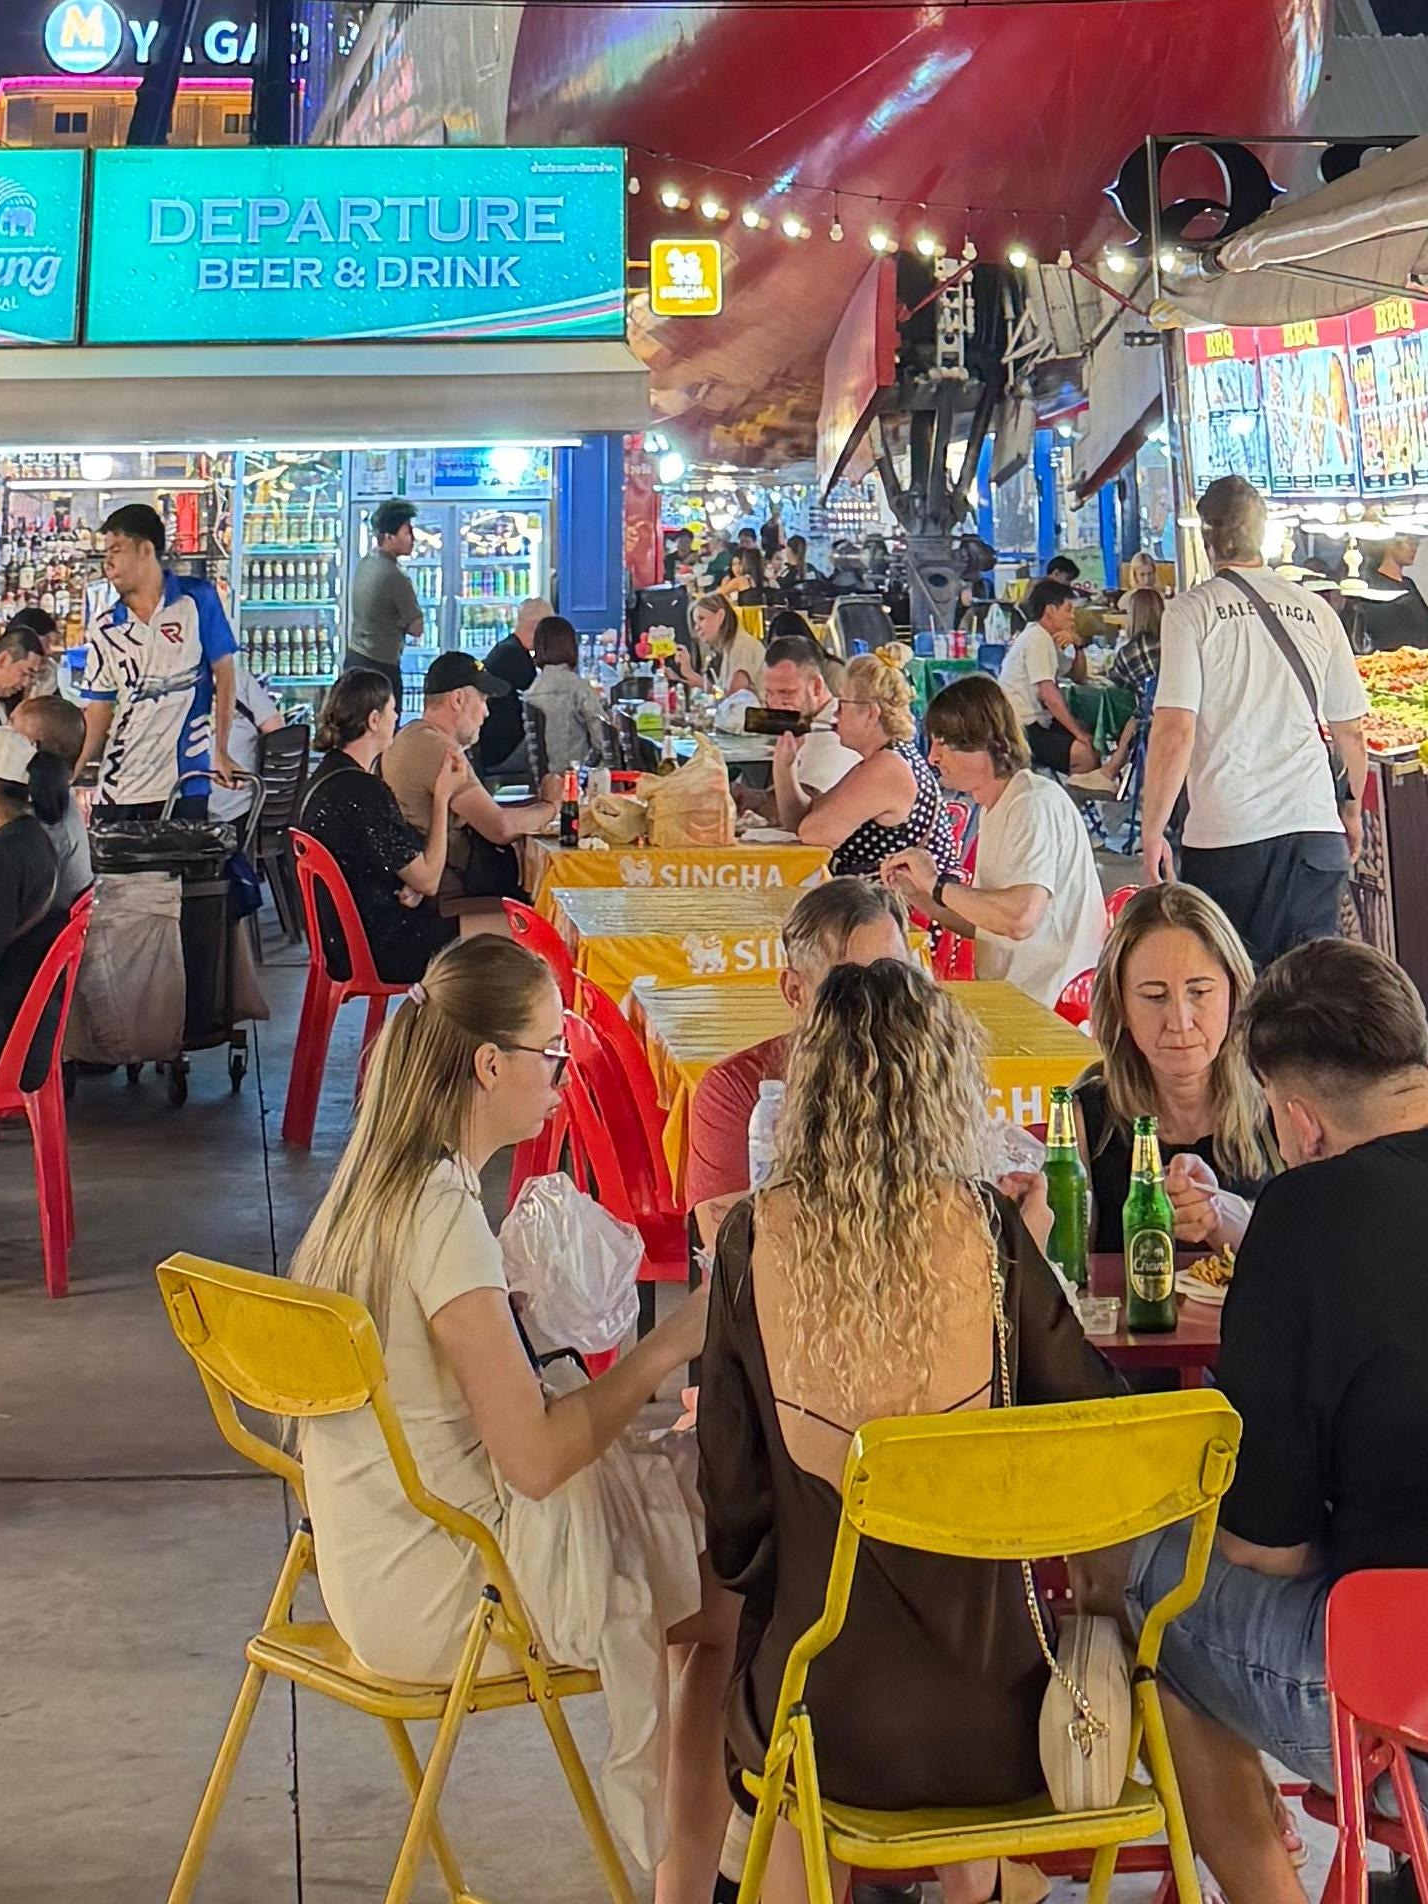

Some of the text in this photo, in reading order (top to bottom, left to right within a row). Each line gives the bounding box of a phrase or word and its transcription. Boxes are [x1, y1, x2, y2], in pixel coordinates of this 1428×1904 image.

[149, 196, 565, 244] DEPARTURE
[198, 256, 521, 290] BEER & DRINK
[1373, 299, 1415, 335] BBQ
[1205, 331, 1235, 358] BBQ
[1282, 320, 1319, 348] BBQ
[1216, 601, 1316, 624] BALECIAGA
[659, 864, 783, 888] SINGHA
